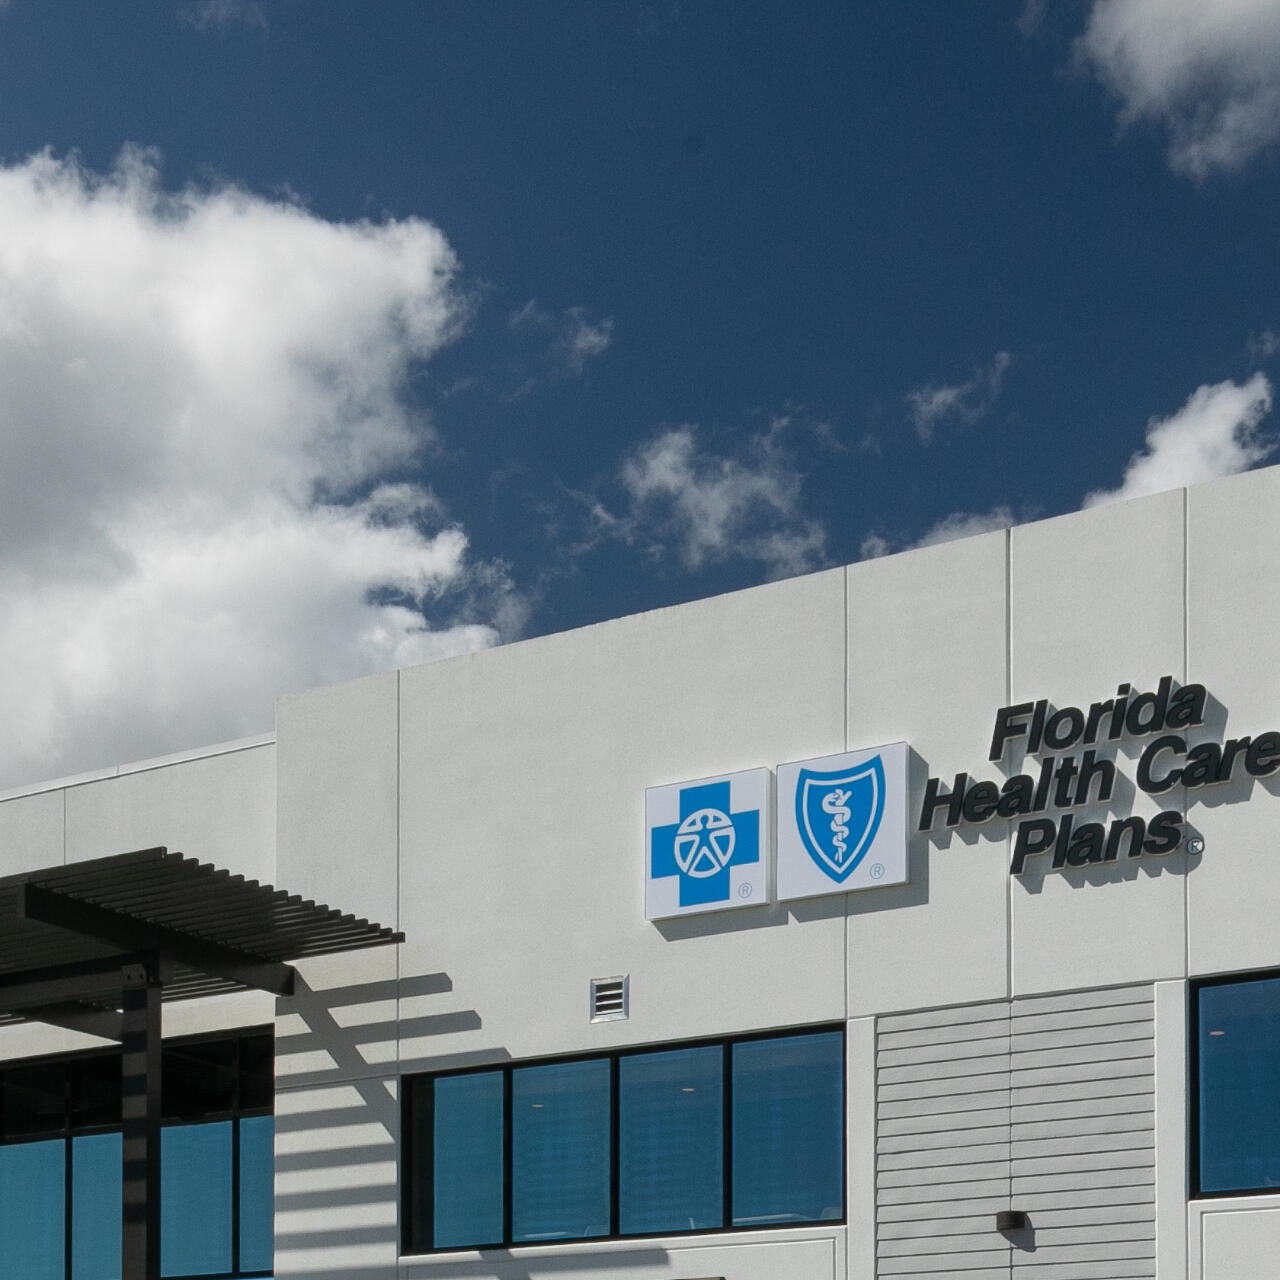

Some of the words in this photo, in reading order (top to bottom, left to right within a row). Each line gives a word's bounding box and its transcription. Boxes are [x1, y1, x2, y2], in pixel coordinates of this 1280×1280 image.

[989, 675, 1206, 762] Florida
[918, 750, 1117, 832] Health
[1010, 810, 1184, 875] Plans
